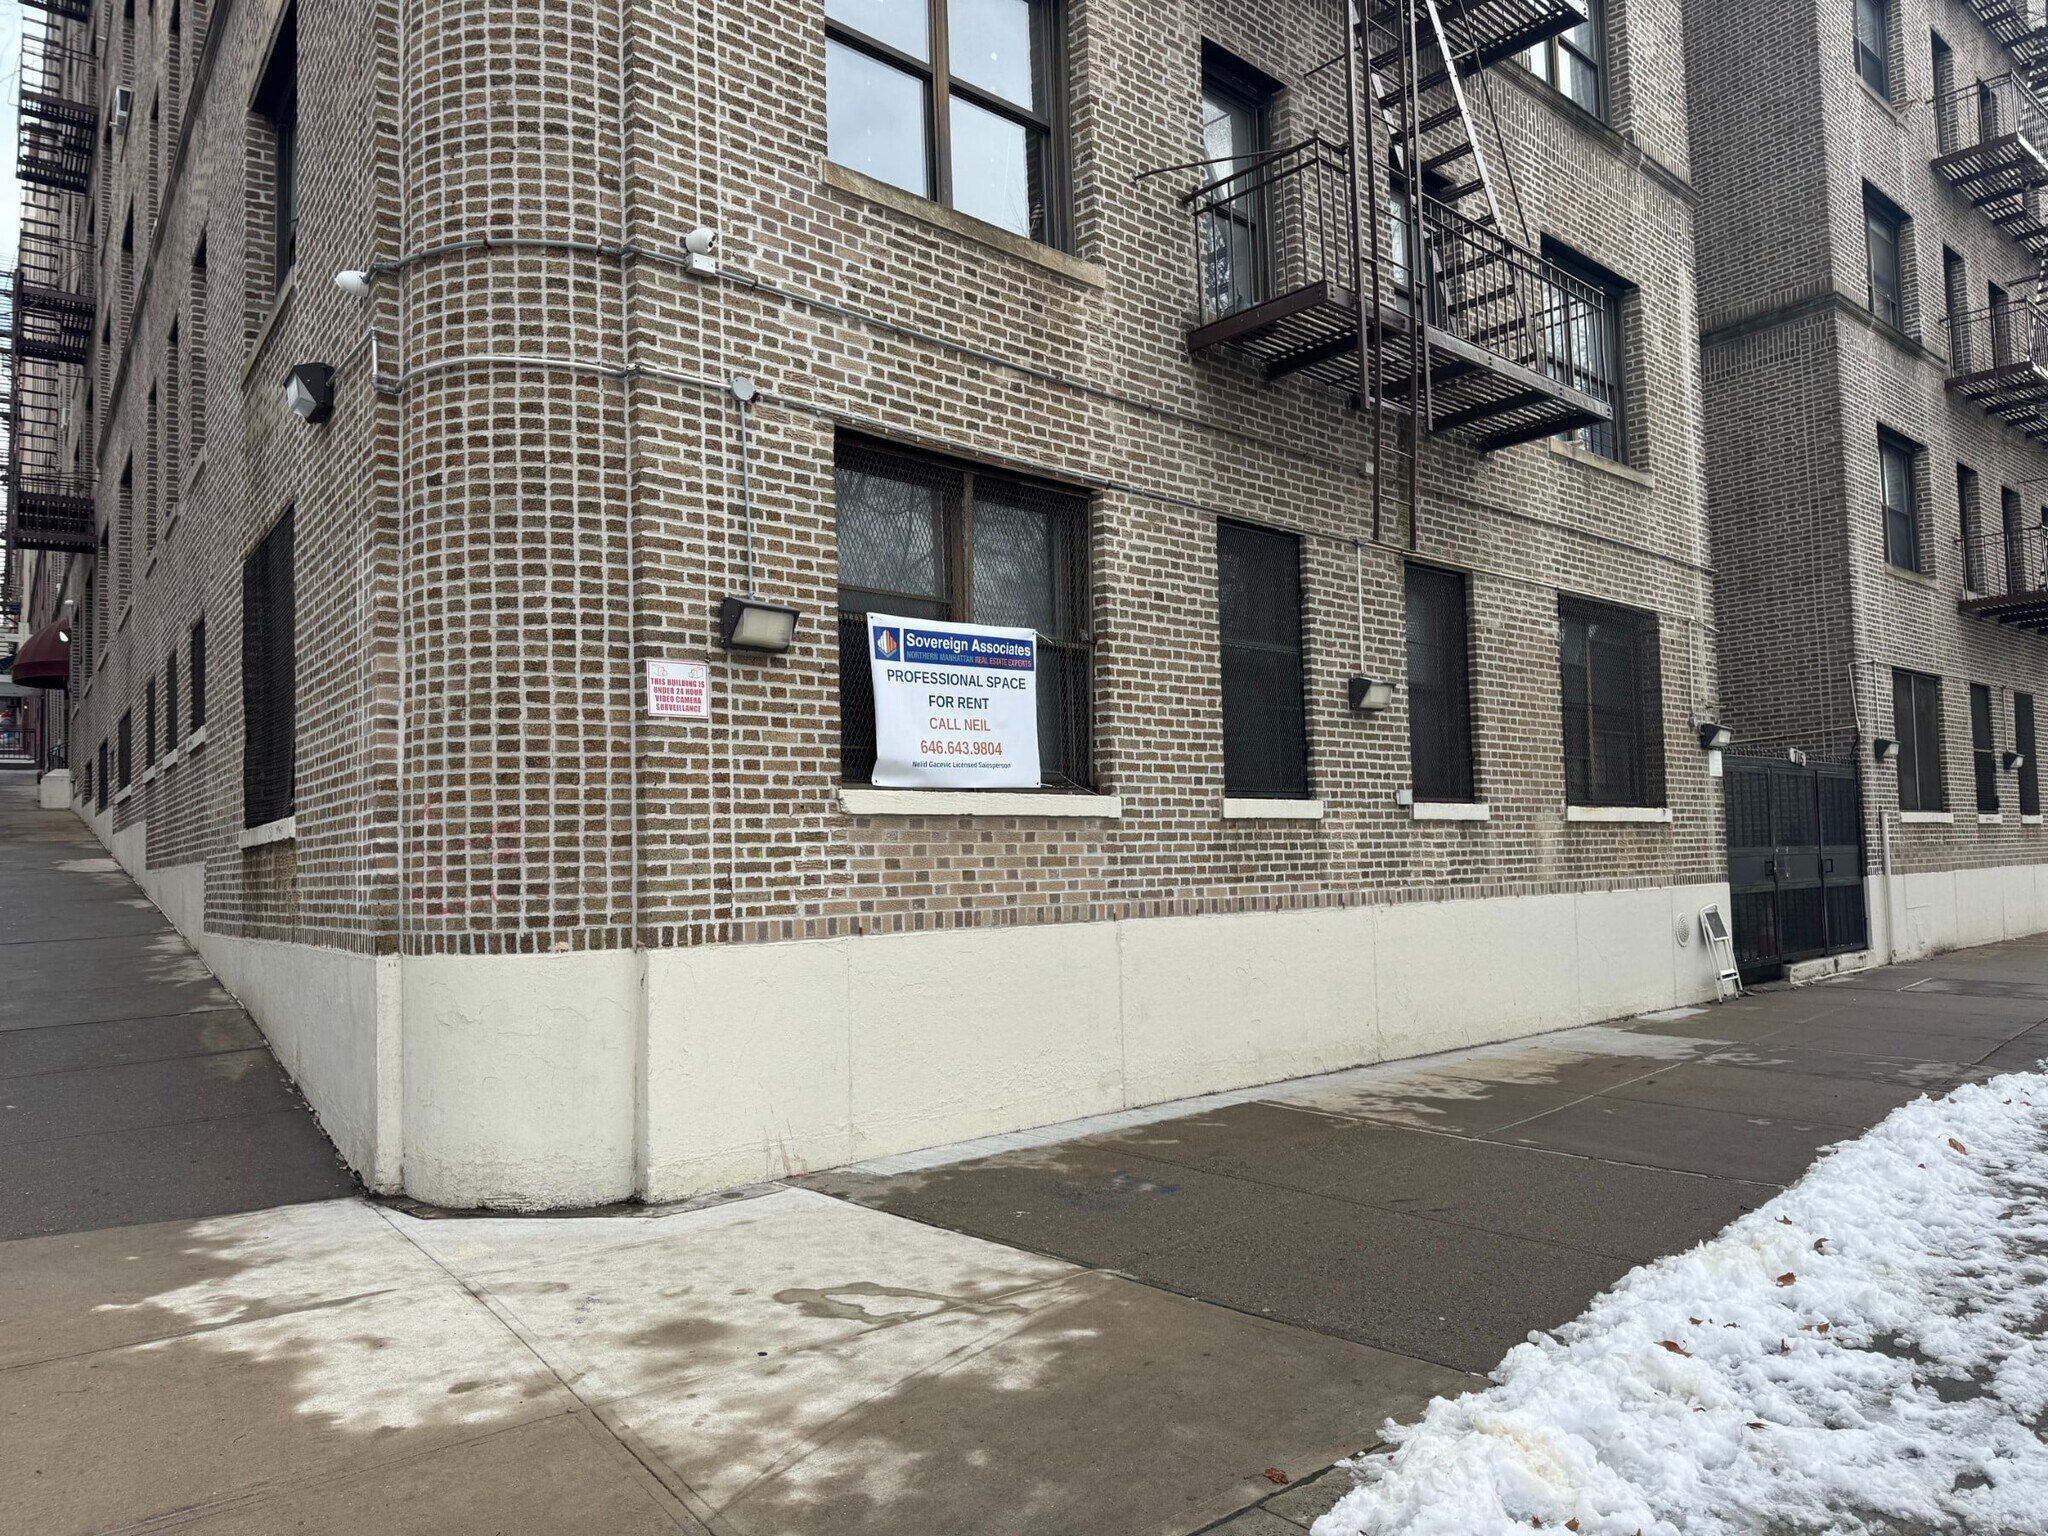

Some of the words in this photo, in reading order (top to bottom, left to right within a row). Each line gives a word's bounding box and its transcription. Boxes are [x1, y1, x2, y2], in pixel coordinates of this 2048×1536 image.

[906, 632, 968, 653] Sovereign
[971, 639, 1031, 657] Associates
[906, 651, 938, 660] NORTHERN
[940, 653, 974, 663] MANHATTAN
[974, 656, 988, 665] REAL
[1008, 659, 1032, 668] EXPERTS
[651, 678, 666, 686] THIS
[667, 679, 697, 687] BUILDING
[887, 669, 983, 688] PROFESSIONAL
[986, 676, 1027, 690] SPACE
[653, 686, 675, 695] UNDER
[685, 688, 703, 696] HOUR
[655, 695, 674, 703] VIDEO
[675, 696, 702, 704] CAMERA
[928, 695, 954, 709] FOR
[957, 697, 989, 710] RENT
[656, 703, 702, 712] SURVEILLANCE
[929, 717, 961, 731] CALL
[964, 719, 991, 731] NEIL
[920, 740, 1003, 756] 646.643.9804
[952, 761, 977, 769] Licensed
[978, 762, 1011, 770] Salesperson
